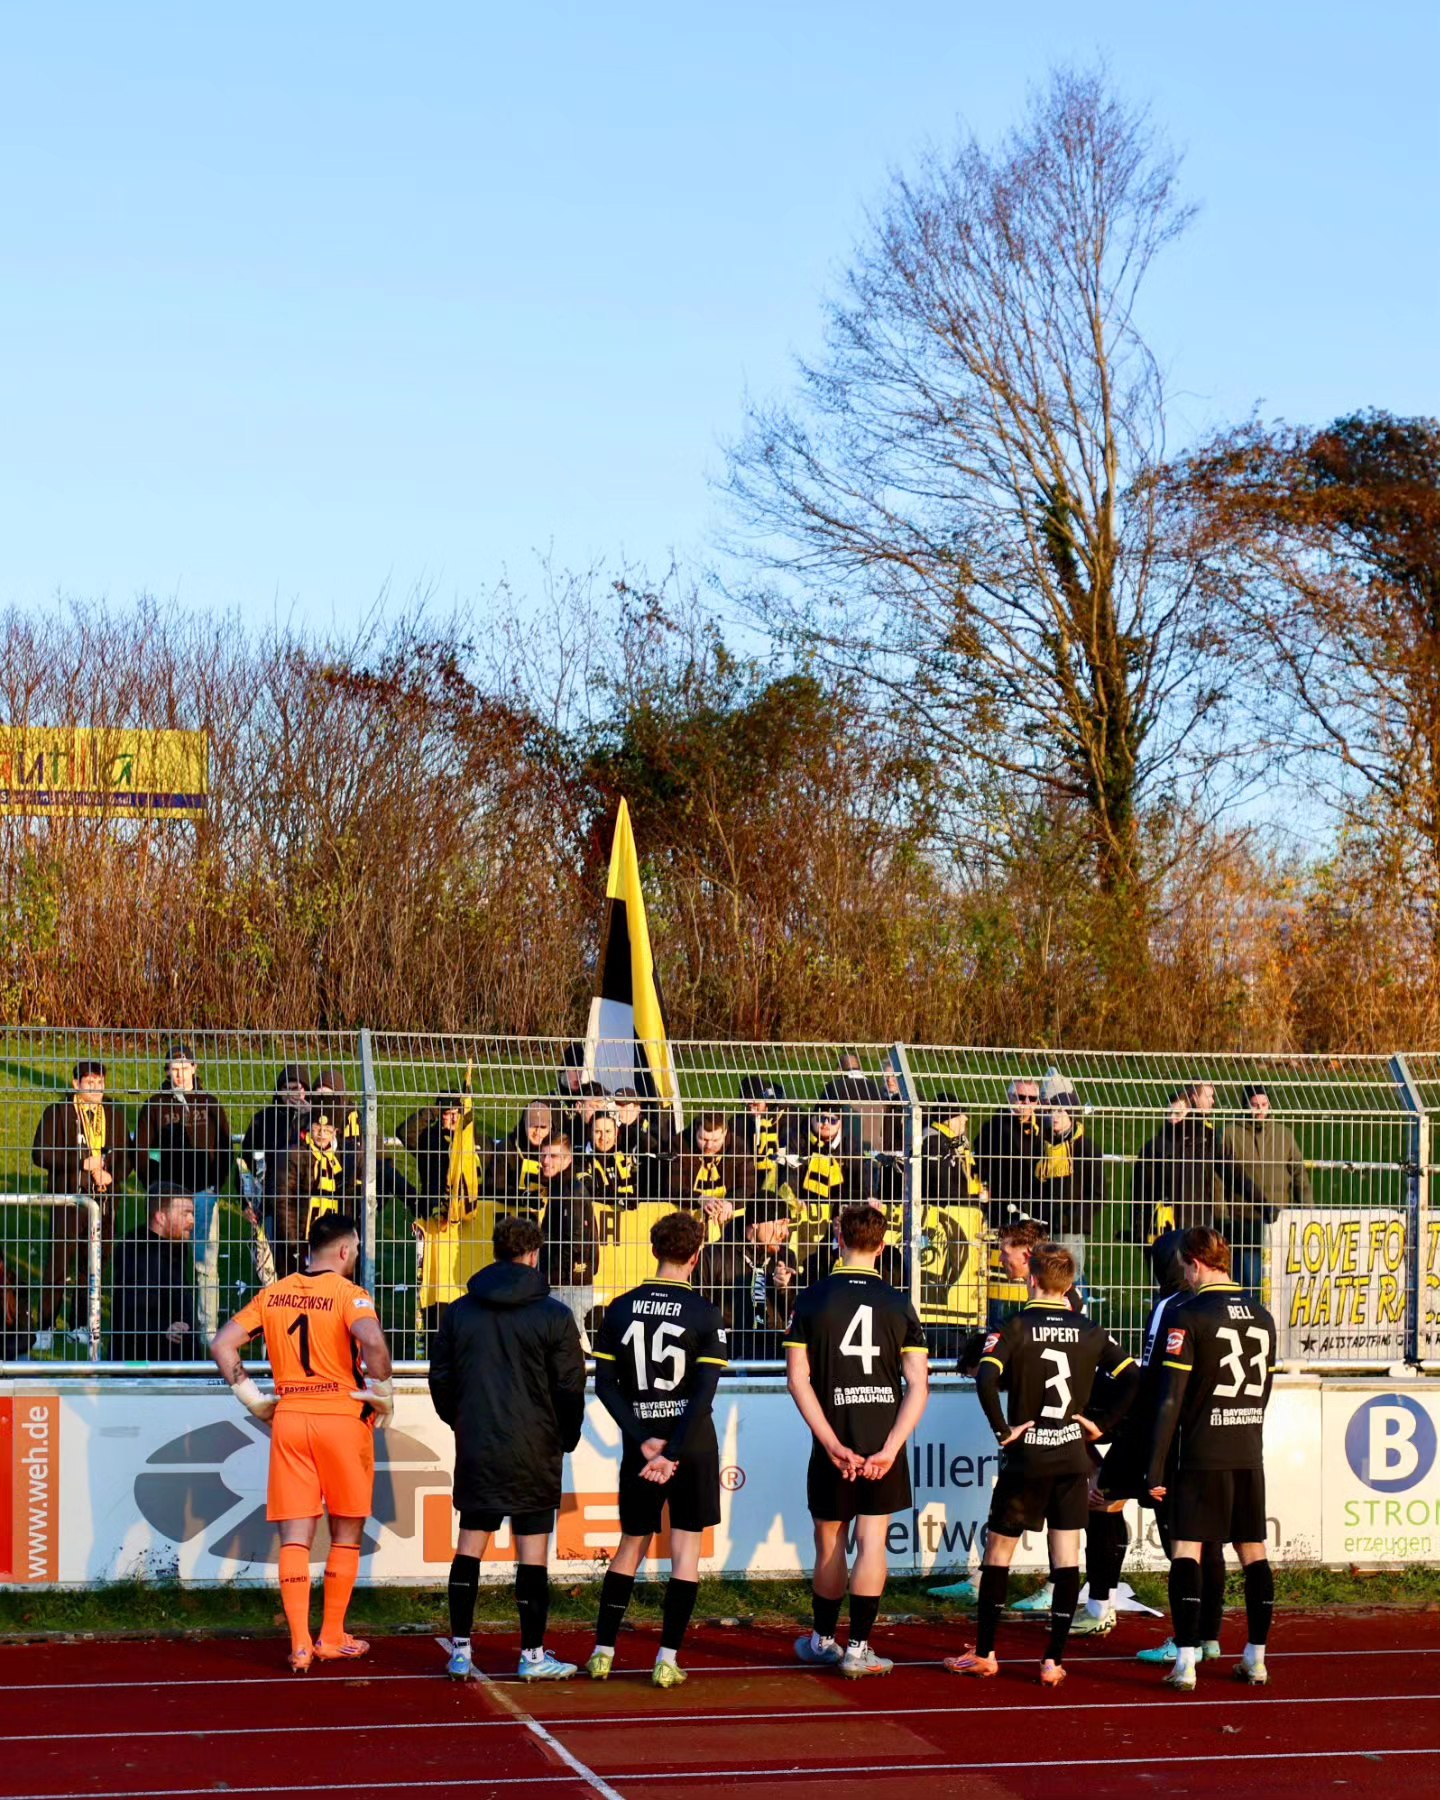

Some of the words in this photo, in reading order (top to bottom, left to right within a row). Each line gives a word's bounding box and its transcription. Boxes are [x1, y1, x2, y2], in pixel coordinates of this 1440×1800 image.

[1286, 1221, 1361, 1275] LOVE
[267, 1294, 334, 1312] ZAHACZEWSKI
[632, 1300, 682, 1317] WEIMER
[1227, 1305, 1255, 1320] BELL
[1289, 1275, 1371, 1329] HATE
[287, 1313, 316, 1377] 1
[839, 1304, 880, 1375] 4
[1032, 1326, 1080, 1343] LIPPERT
[621, 1320, 686, 1391] 15
[1213, 1326, 1270, 1398] 33
[844, 1386, 893, 1396] BAYREUTHER
[1040, 1348, 1072, 1420] 3
[639, 1399, 689, 1411] BAYREUTHE
[845, 1393, 895, 1404] BRAUHAUS
[1222, 1407, 1263, 1417] BAYREUTHE
[1222, 1415, 1263, 1426] BRAUHAU
[1369, 1405, 1419, 1481] B
[22, 1405, 49, 1579] www.weh.de
[1344, 1499, 1440, 1527] STRO
[1344, 1535, 1432, 1558] erzeugen
